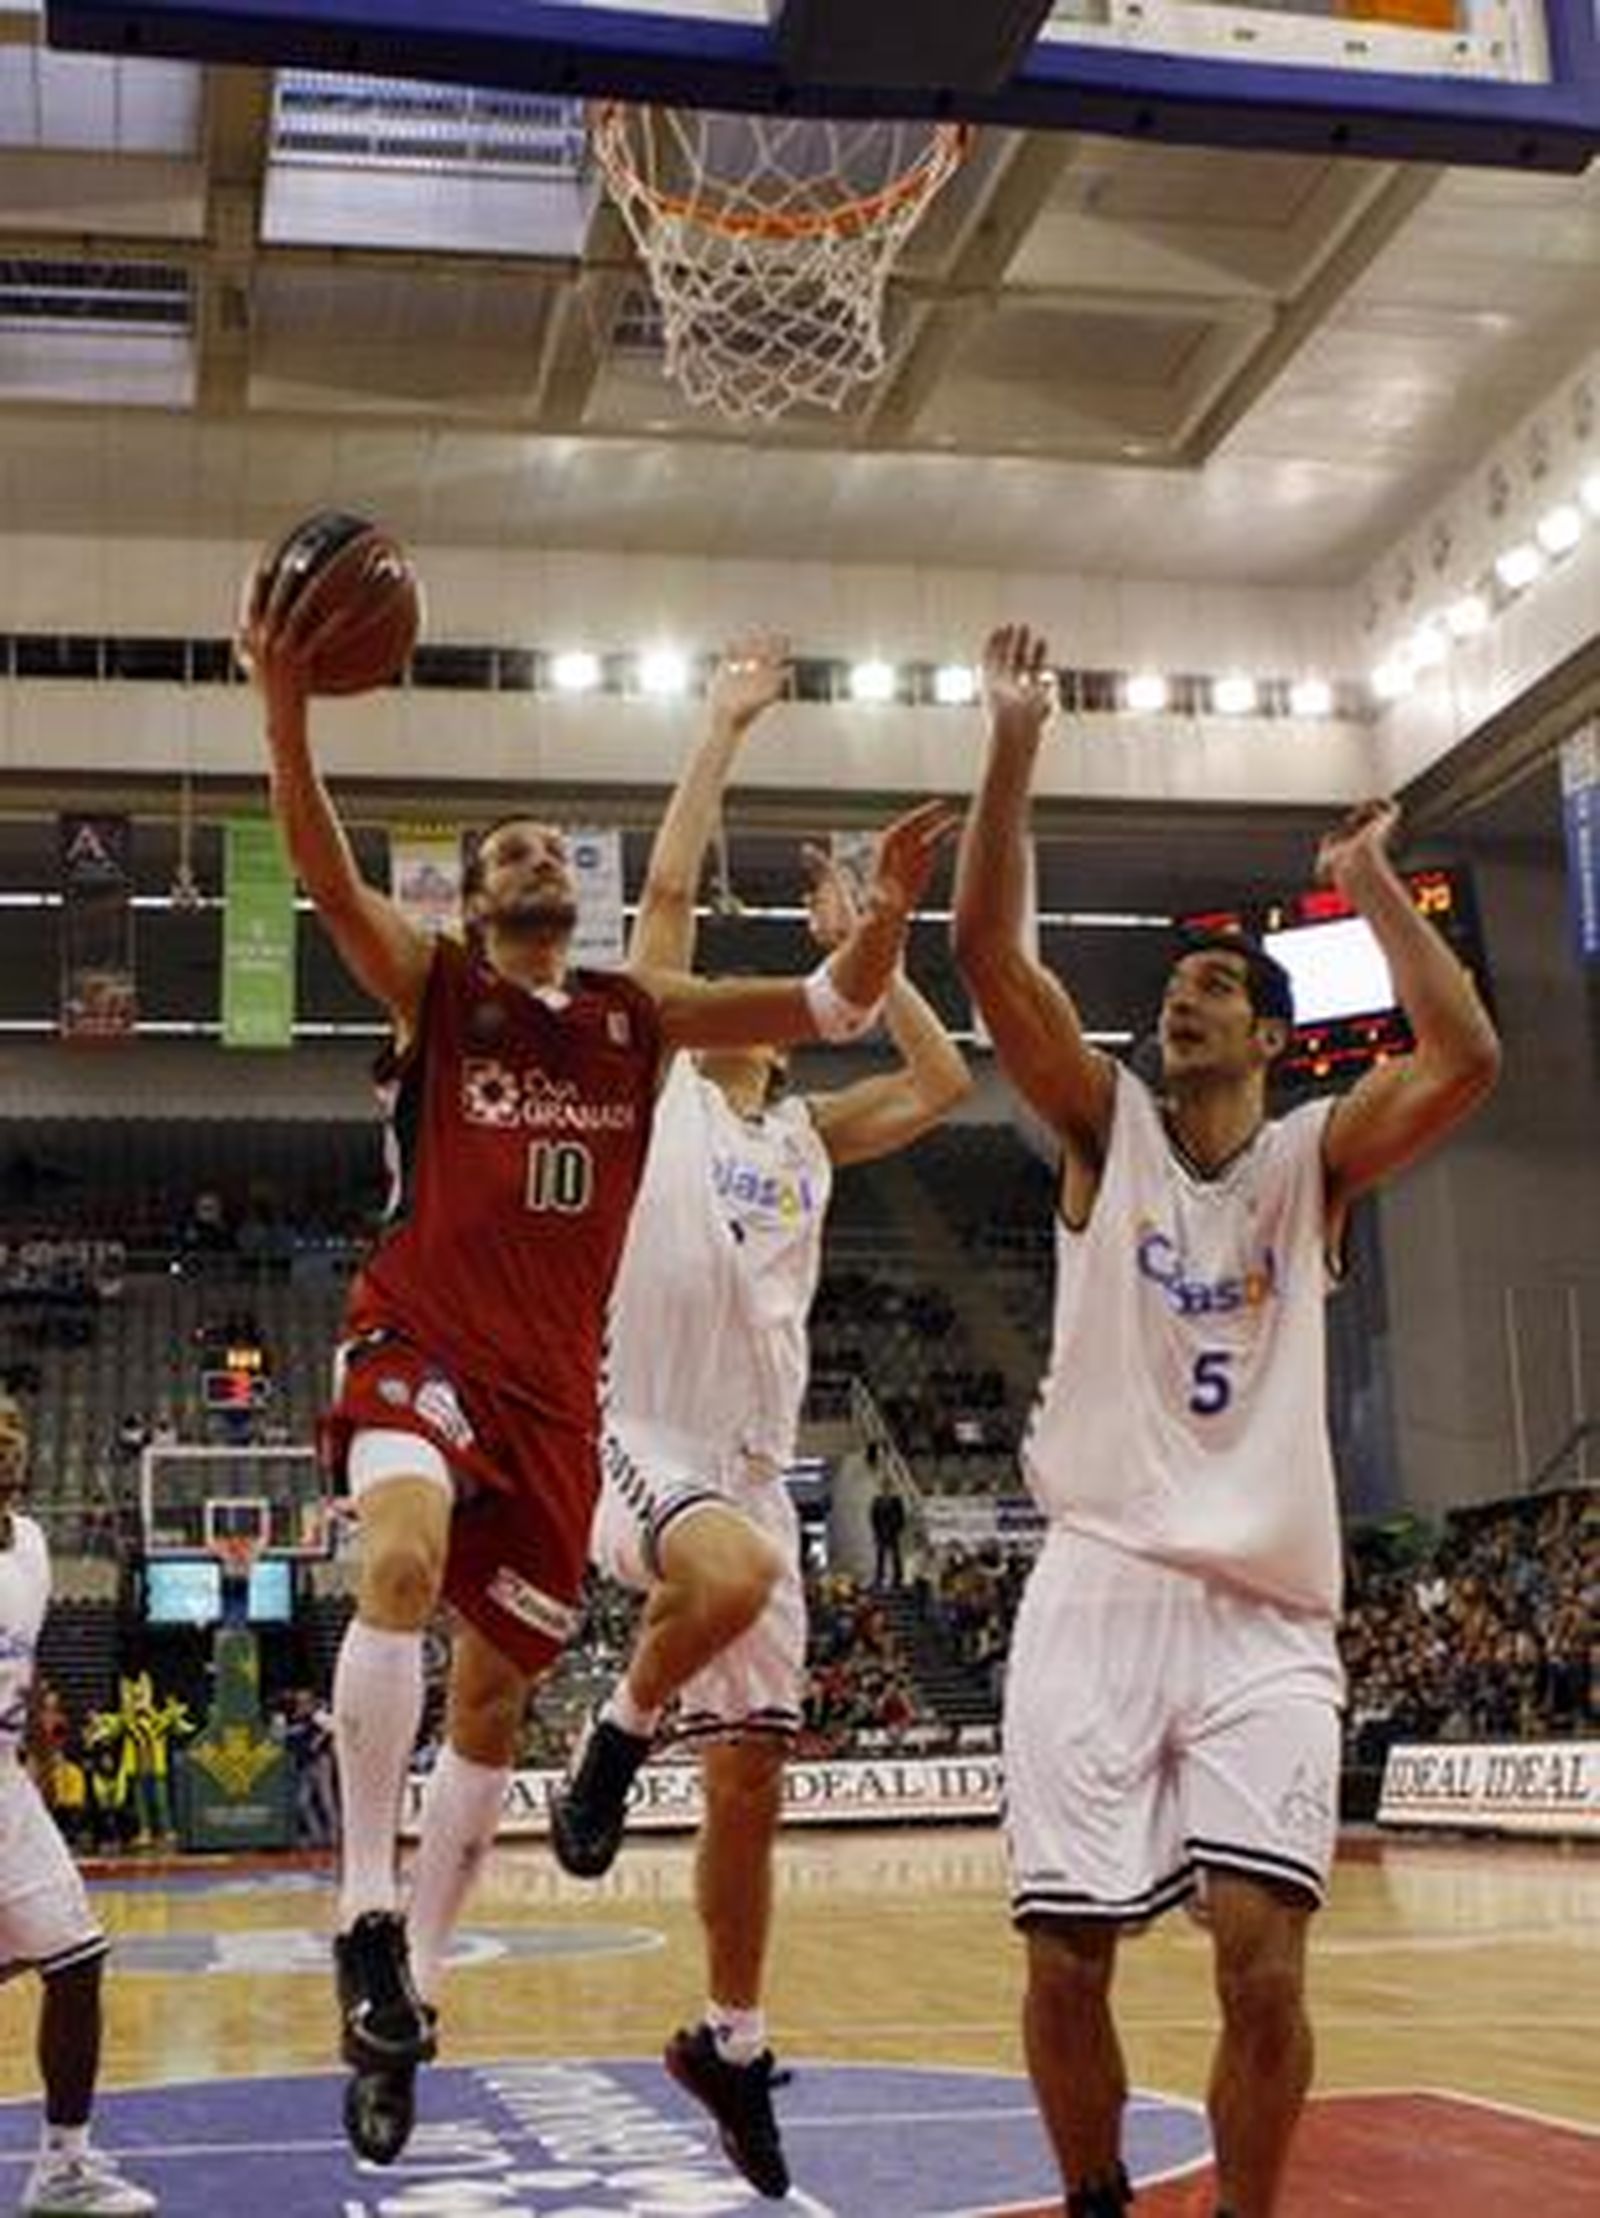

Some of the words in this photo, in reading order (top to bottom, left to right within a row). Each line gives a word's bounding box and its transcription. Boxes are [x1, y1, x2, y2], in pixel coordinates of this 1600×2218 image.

[526, 1139, 594, 1214] 10
[1189, 1351, 1231, 1415] 5
[785, 1768, 924, 1802] DEAL
